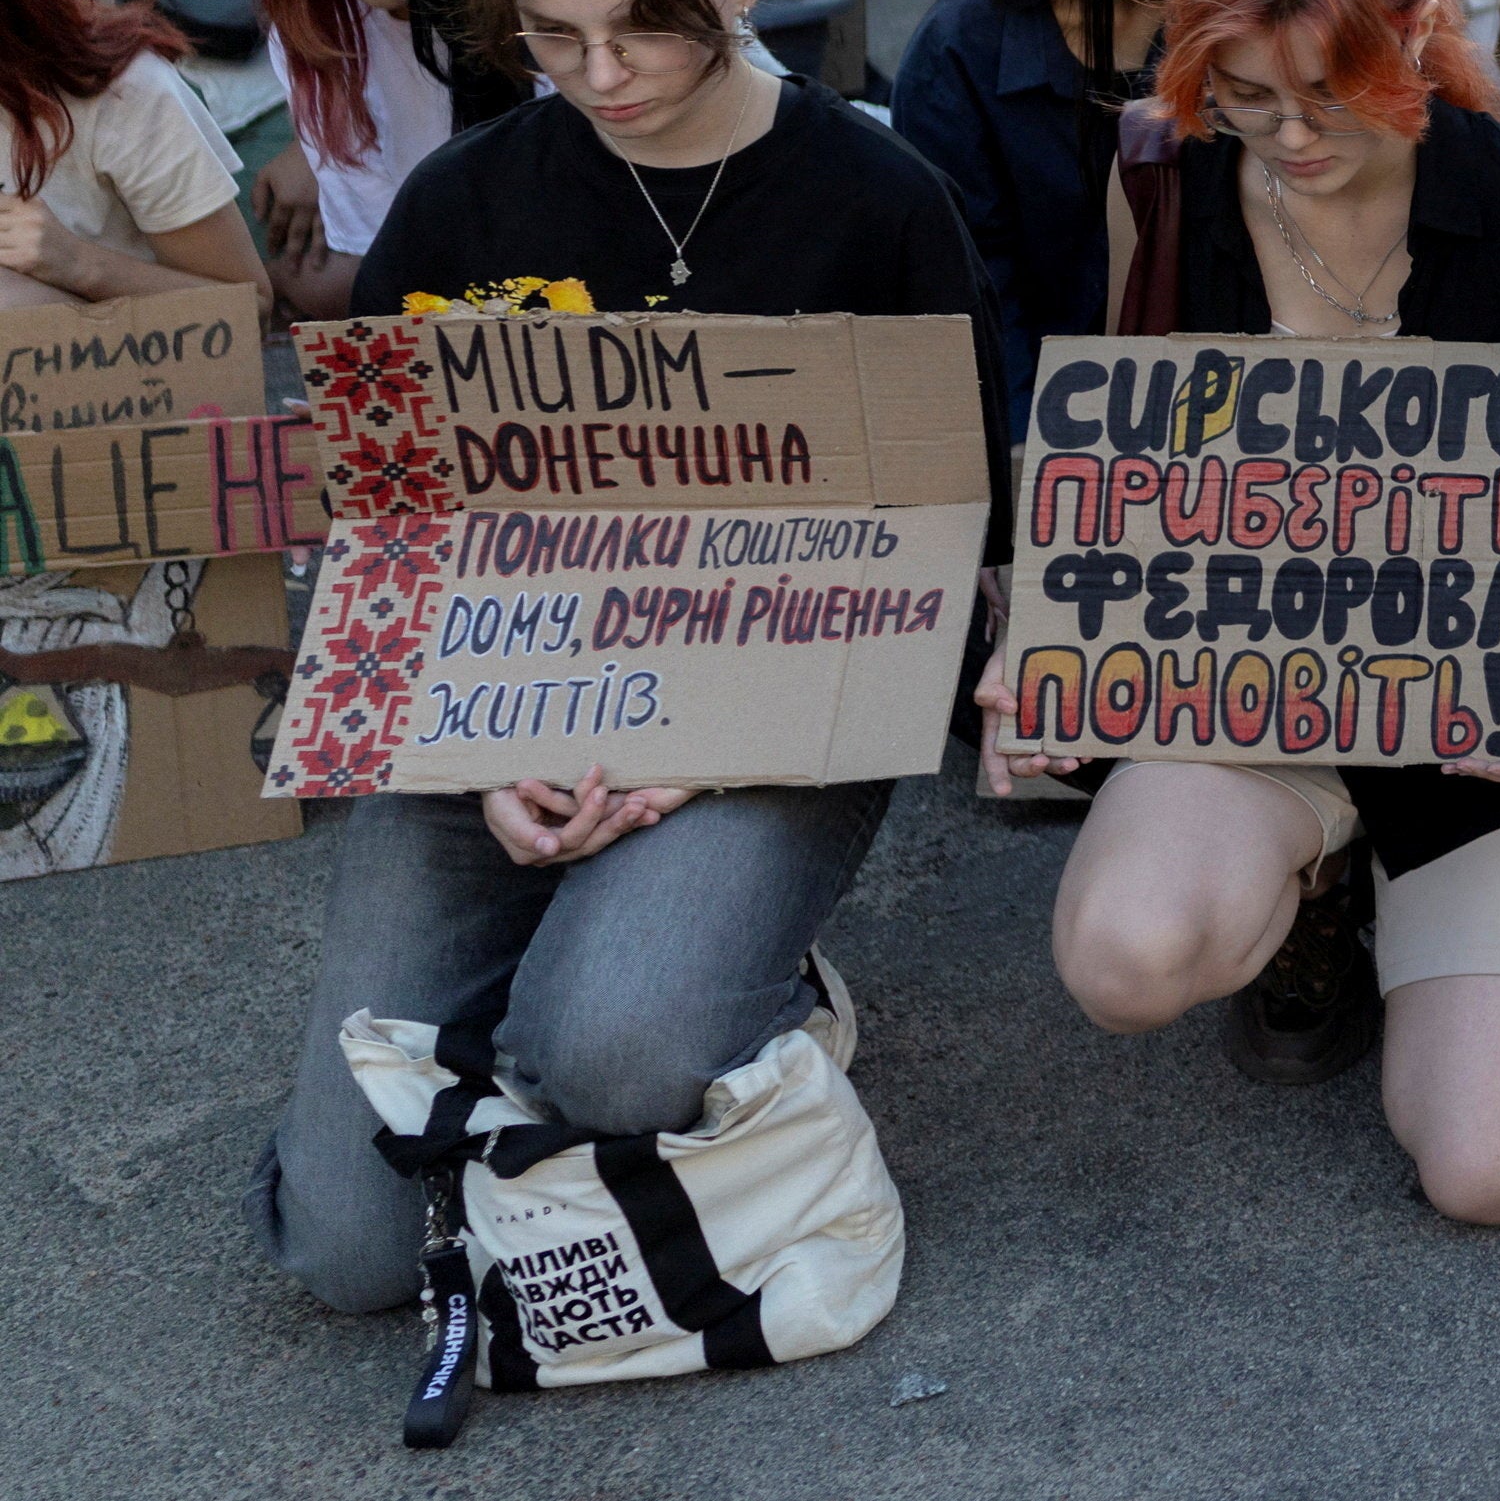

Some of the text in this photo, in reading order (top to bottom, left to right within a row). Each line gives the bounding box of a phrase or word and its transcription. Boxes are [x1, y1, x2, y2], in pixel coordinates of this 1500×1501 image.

[435, 320, 576, 414] МІЙ
[51, 426, 191, 559] ЦЕ
[208, 414, 327, 556] НЕ
[455, 511, 901, 580] ПОМИЛКИ КОШТУЮТЬ
[735, 573, 946, 647] РІШЕННЯ
[415, 662, 673, 745] ЖИТТІВ.
[422, 1293, 468, 1401] СХІДНЯЧКА
